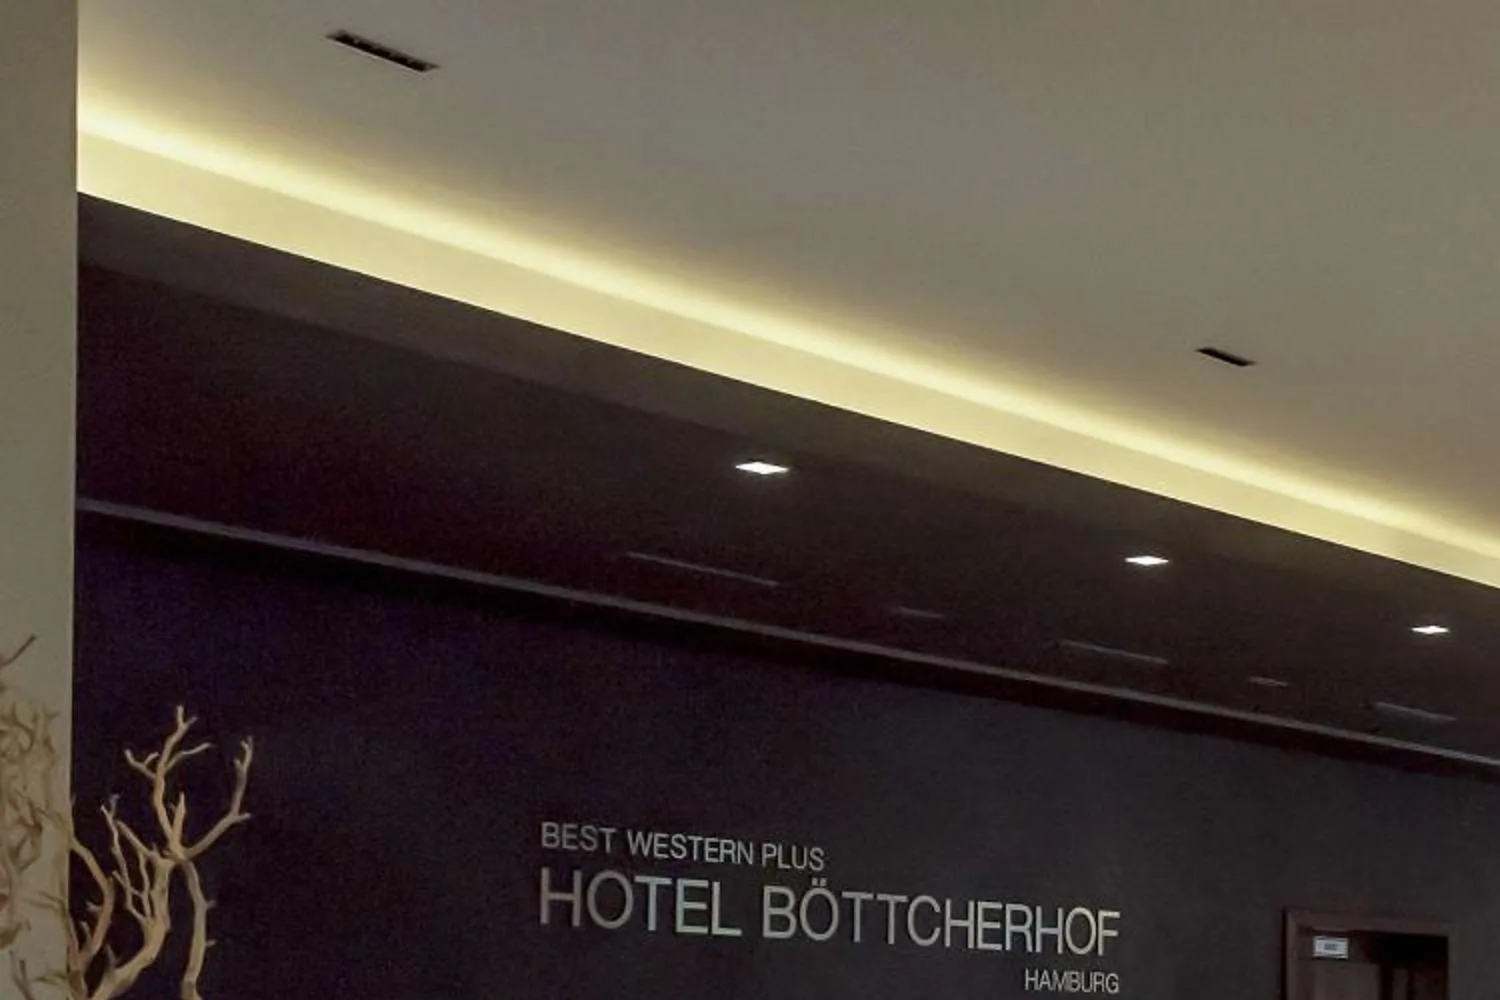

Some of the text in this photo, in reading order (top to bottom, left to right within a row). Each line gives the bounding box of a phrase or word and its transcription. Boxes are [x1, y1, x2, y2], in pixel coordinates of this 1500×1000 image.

[542, 822, 825, 872] BEST WESTERN PLUS
[540, 868, 1121, 957] HOTEL BÖTTCHERHOF
[1024, 968, 1120, 995] HAMBURG
